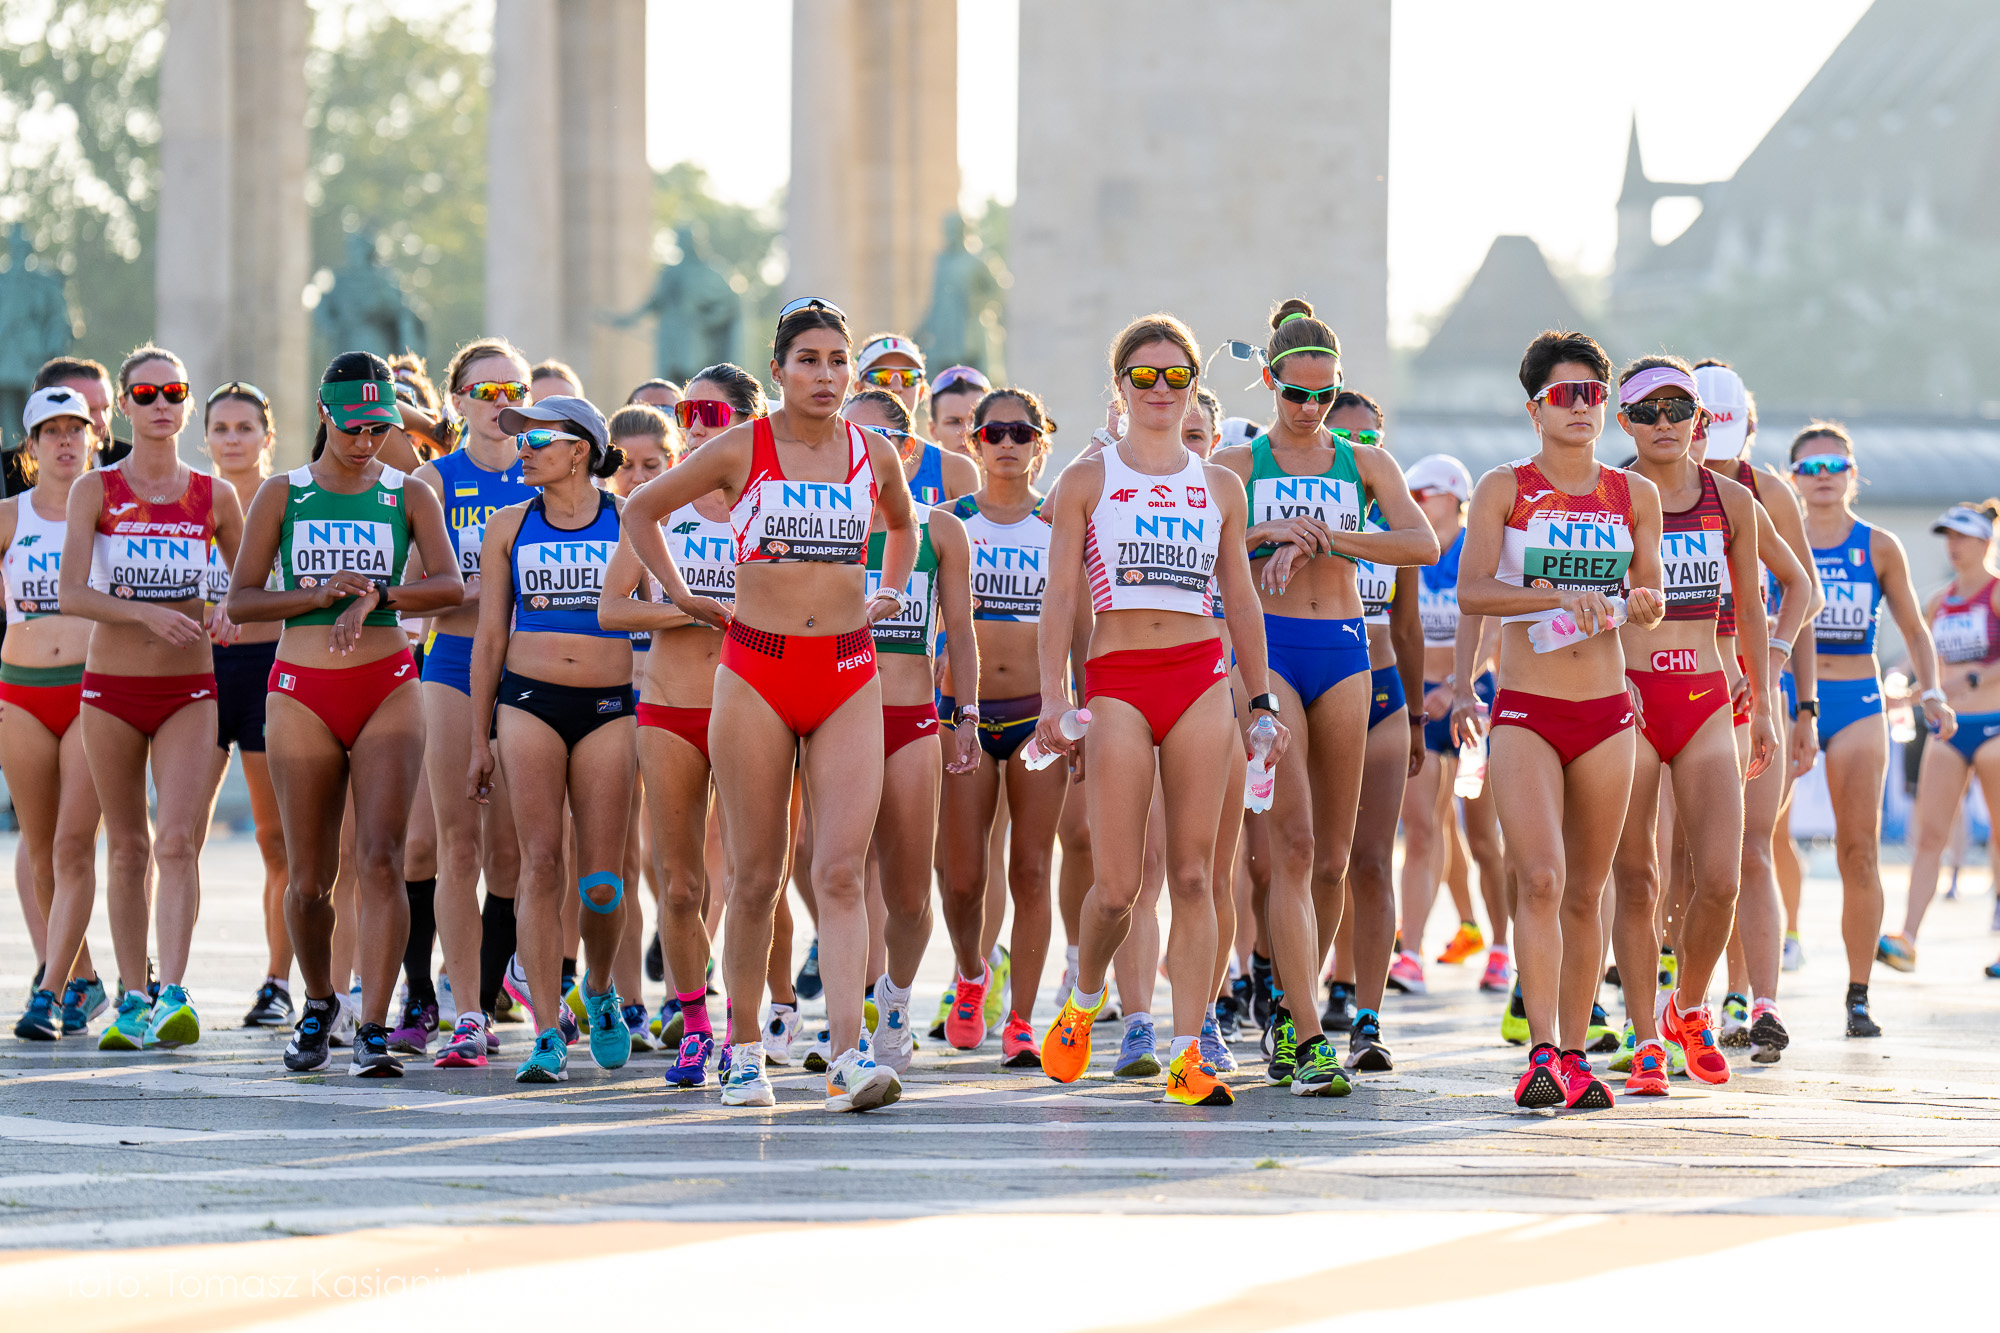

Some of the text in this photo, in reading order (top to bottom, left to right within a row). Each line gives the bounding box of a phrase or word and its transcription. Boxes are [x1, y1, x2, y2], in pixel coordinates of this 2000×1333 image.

[783, 482, 852, 511] NTN
[1275, 478, 1341, 504] NTN
[114, 521, 204, 536] ESPAÑA
[764, 512, 866, 541] GARCÍA LEÓN
[1136, 514, 1204, 543] NTN
[1339, 512, 1357, 531] 106
[1532, 509, 1624, 525] ESPAÑA
[308, 522, 376, 546] NTN
[1548, 522, 1616, 550] NTN
[1661, 532, 1707, 558] TN
[127, 538, 189, 560] NTN
[297, 548, 387, 571] ORTEGA
[539, 542, 607, 565] NTN
[684, 536, 735, 563] NT
[976, 546, 1039, 572] NTN
[1117, 541, 1215, 572] ZDZIEBŁO 167
[28, 552, 61, 573] NT
[113, 563, 202, 585] GONZÁLEZ
[1542, 551, 1618, 579] PÉREZ
[1664, 560, 1719, 585] YANG
[970, 572, 1046, 597] ONILLA
[837, 649, 872, 673] PERÚ
[1652, 650, 1697, 672] CHN
[1499, 709, 1529, 720] ESP
